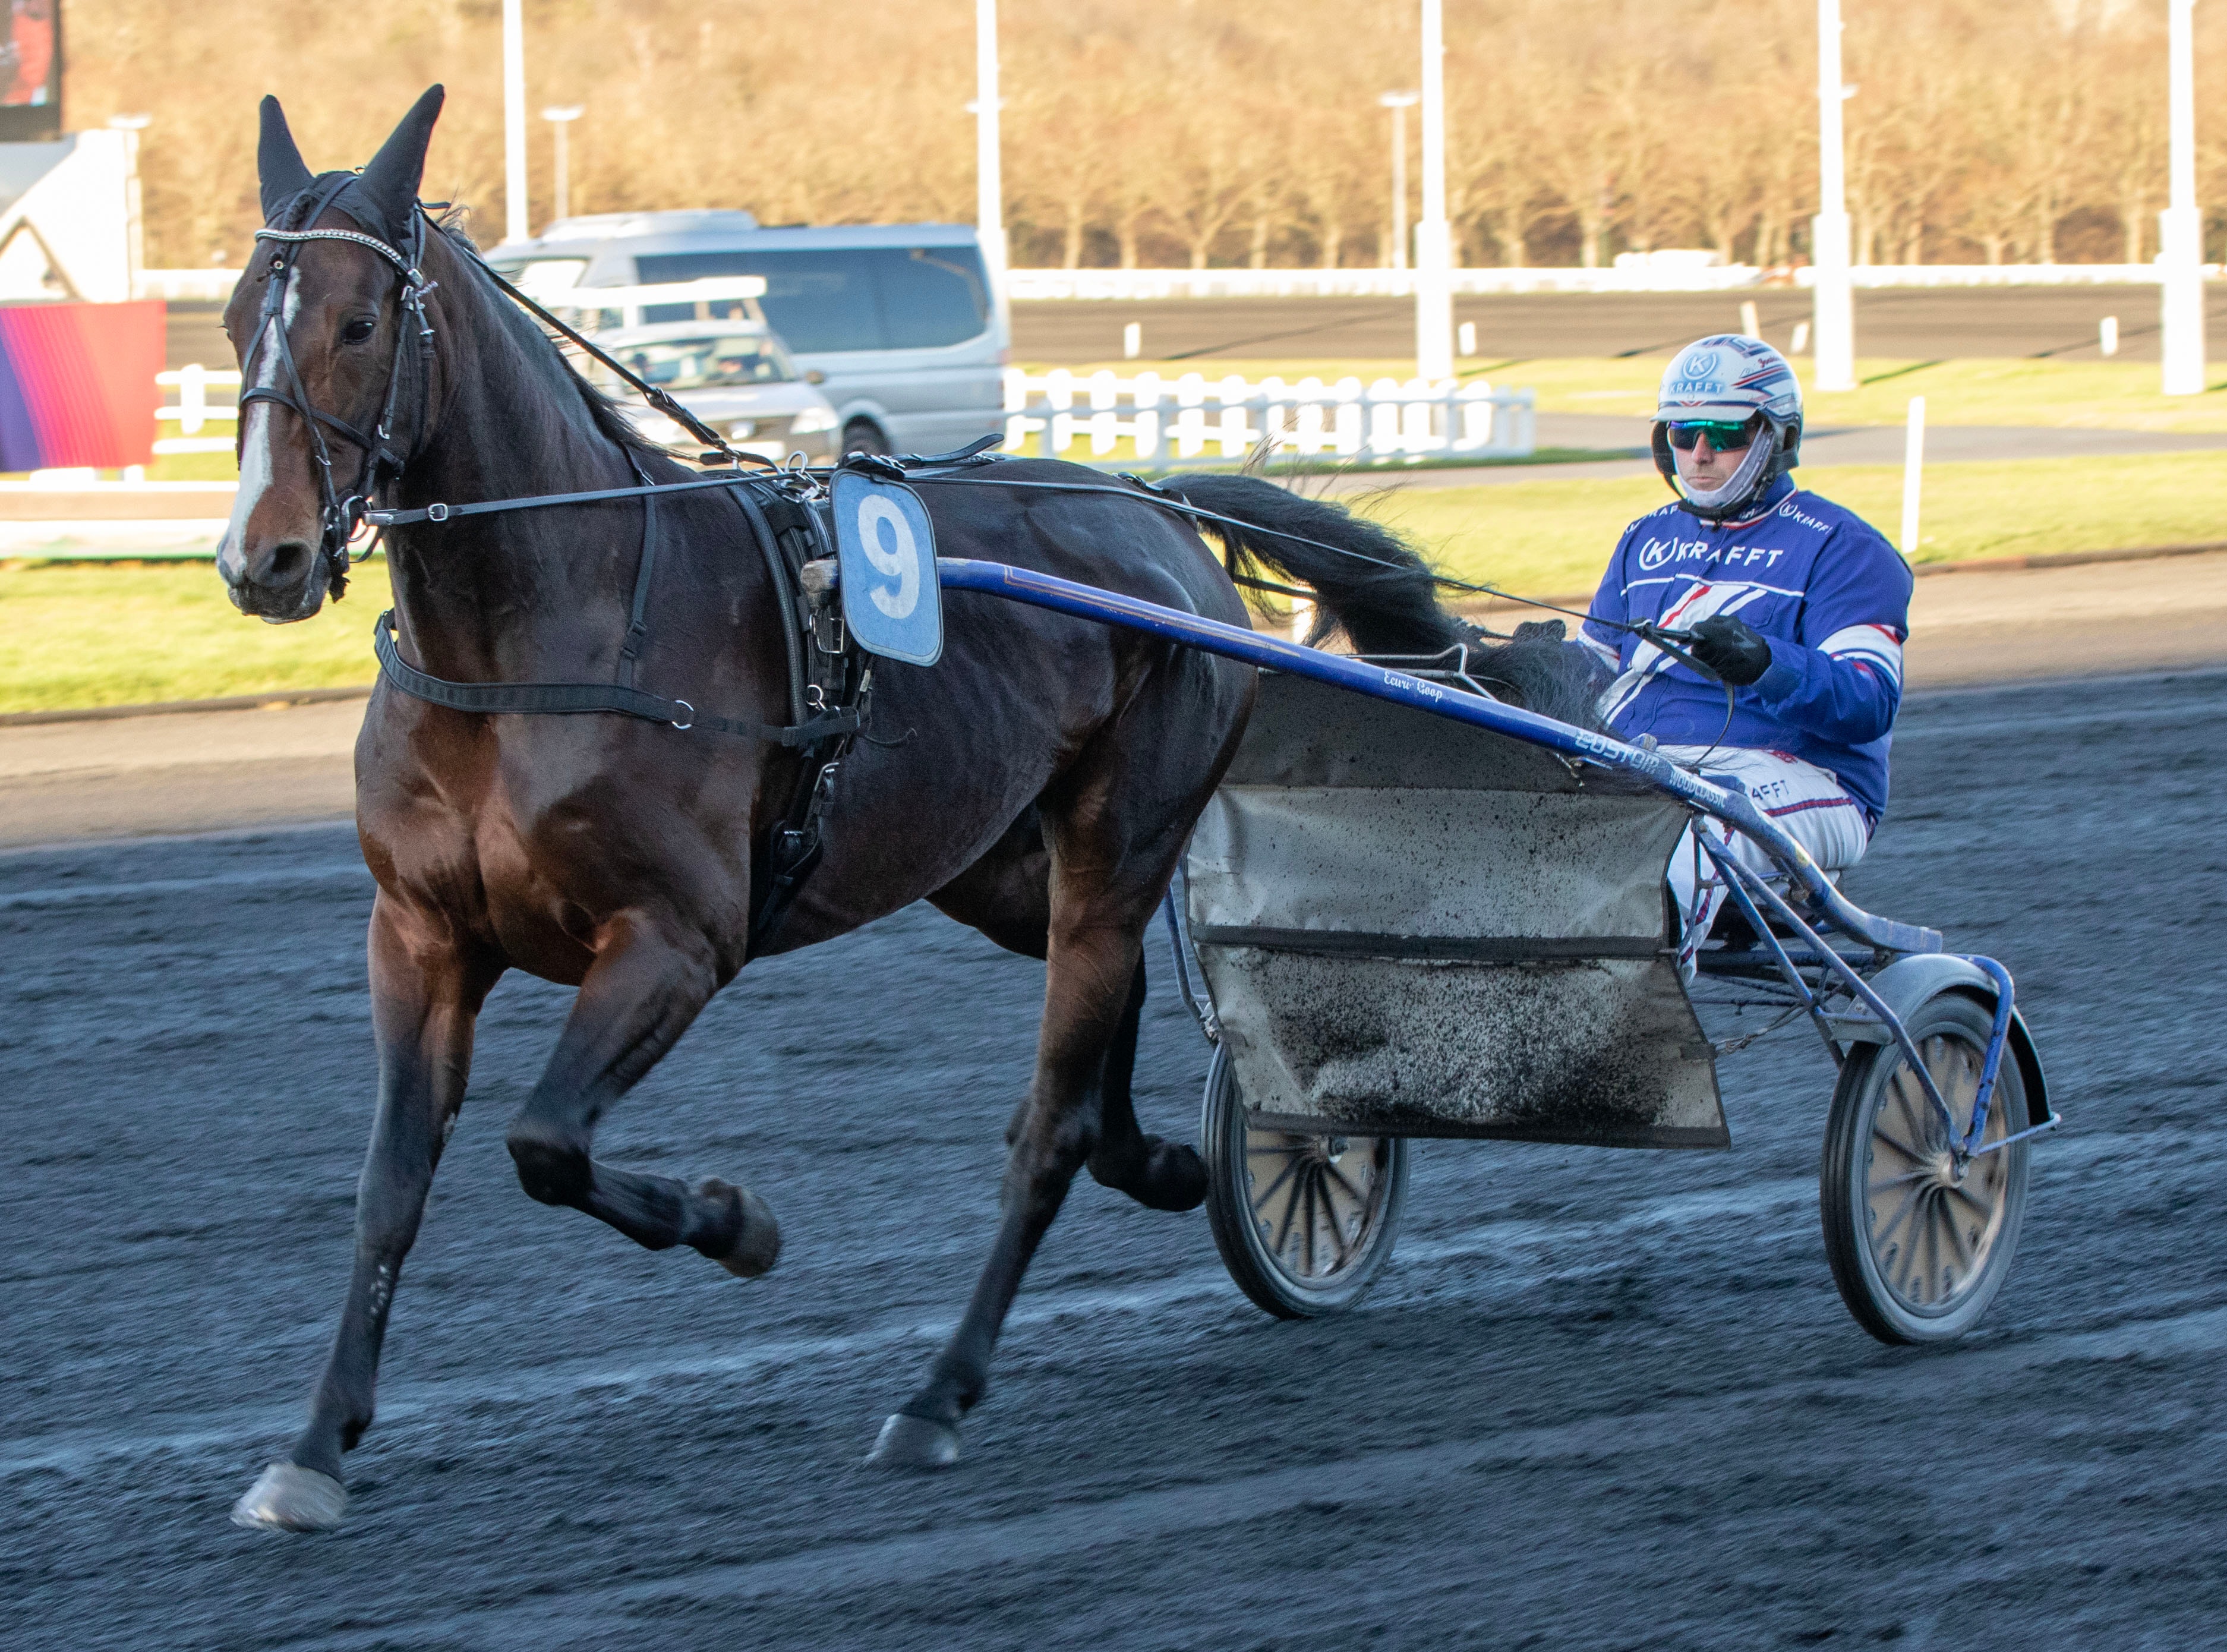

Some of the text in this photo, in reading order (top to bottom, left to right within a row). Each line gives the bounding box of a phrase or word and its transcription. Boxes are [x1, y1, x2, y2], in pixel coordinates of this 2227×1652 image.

[1669, 382, 1723, 395] KRAFFT
[857, 494, 920, 619] 9
[1674, 540, 1784, 568] KRAFFT
